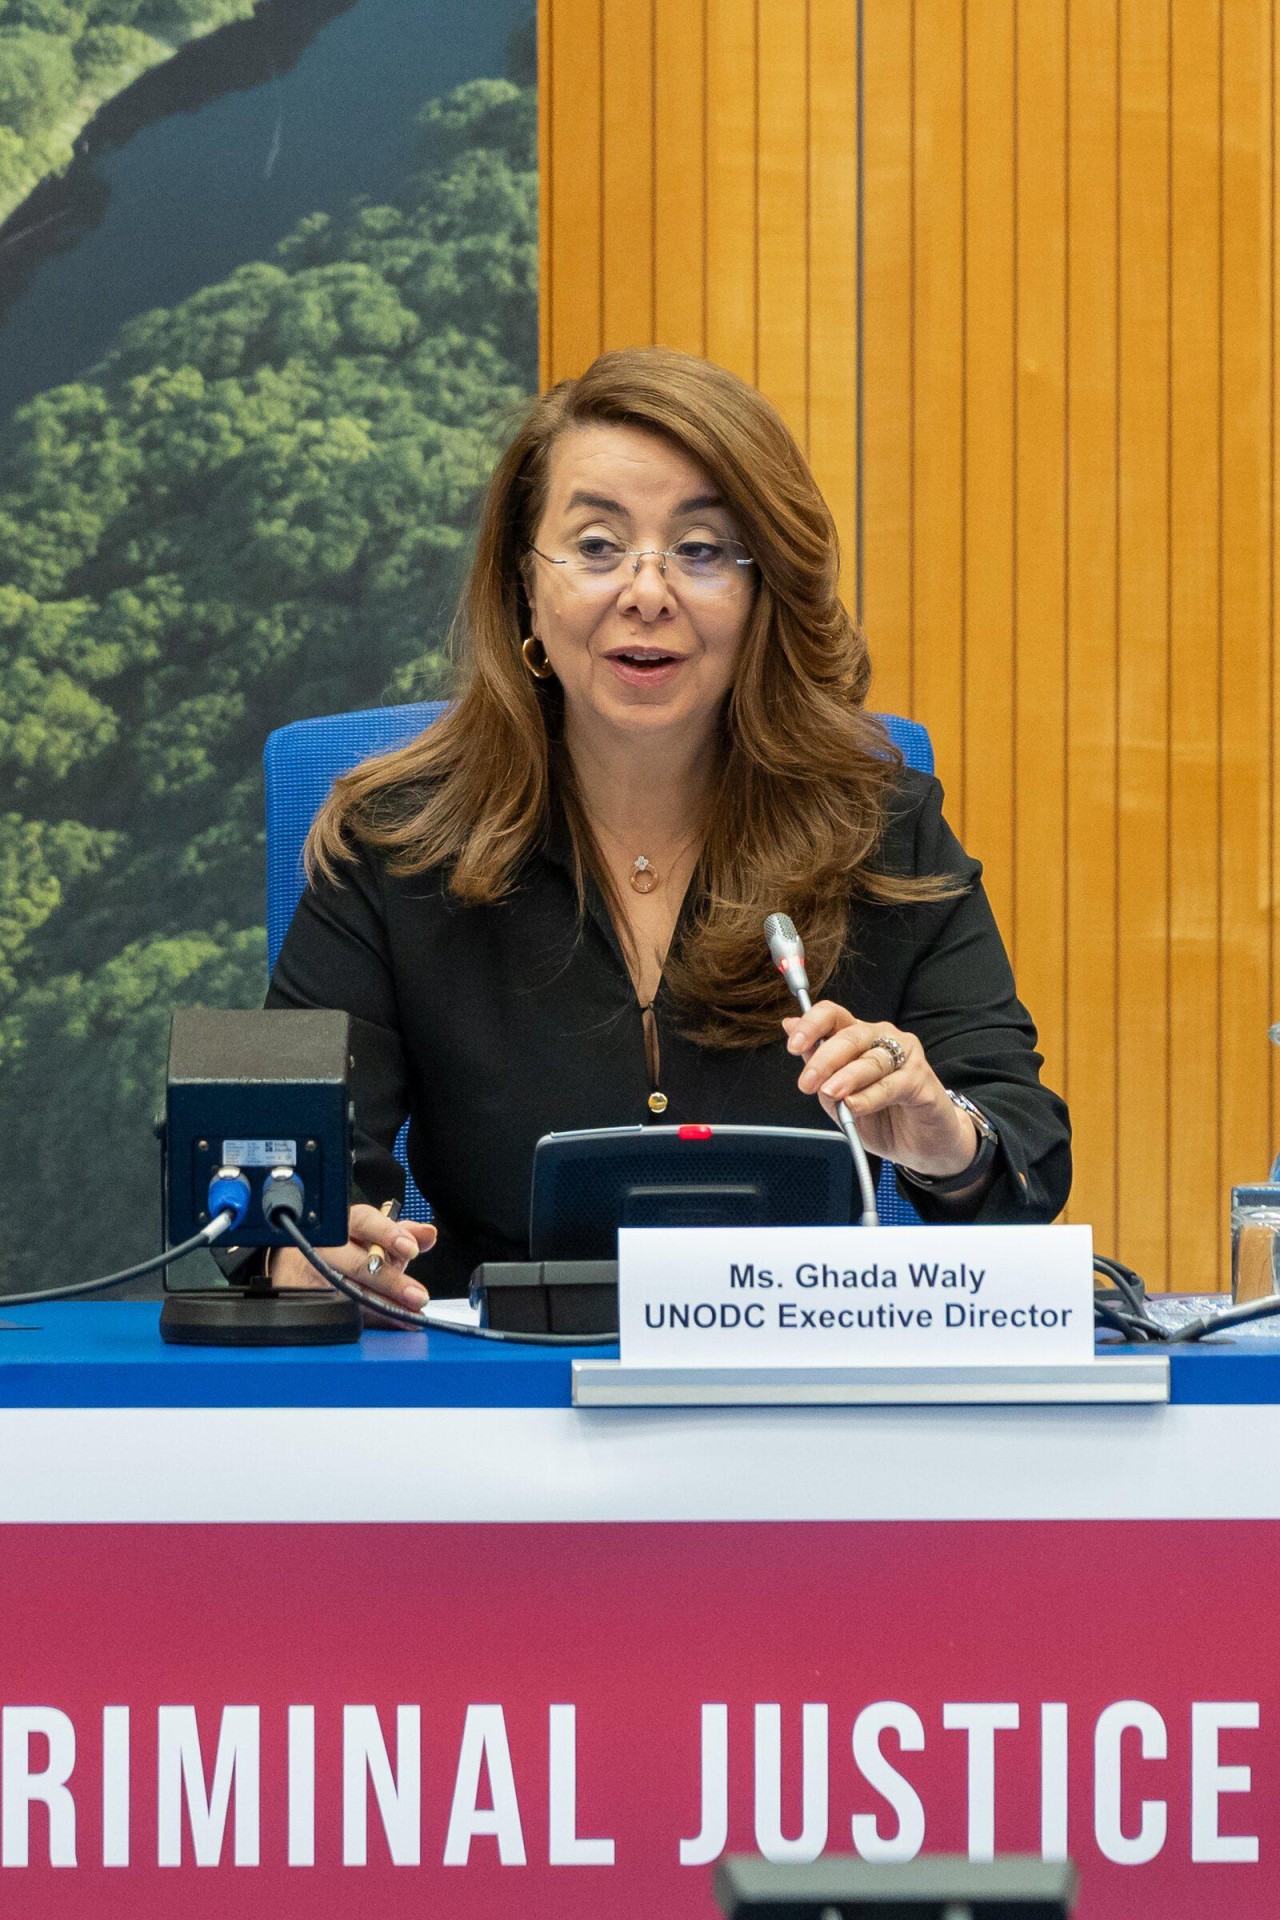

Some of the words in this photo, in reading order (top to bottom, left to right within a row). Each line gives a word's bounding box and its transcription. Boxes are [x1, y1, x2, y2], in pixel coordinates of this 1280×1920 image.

[731, 1263, 783, 1288] Ms.
[796, 1263, 897, 1288] Ghada
[909, 1263, 986, 1295] Waly
[645, 1303, 765, 1328] UNODC
[778, 1303, 933, 1328] Executive
[945, 1303, 1073, 1328] Director
[1, 1704, 615, 1867] RIMINAL
[679, 1700, 1260, 1865] JUSTICE
